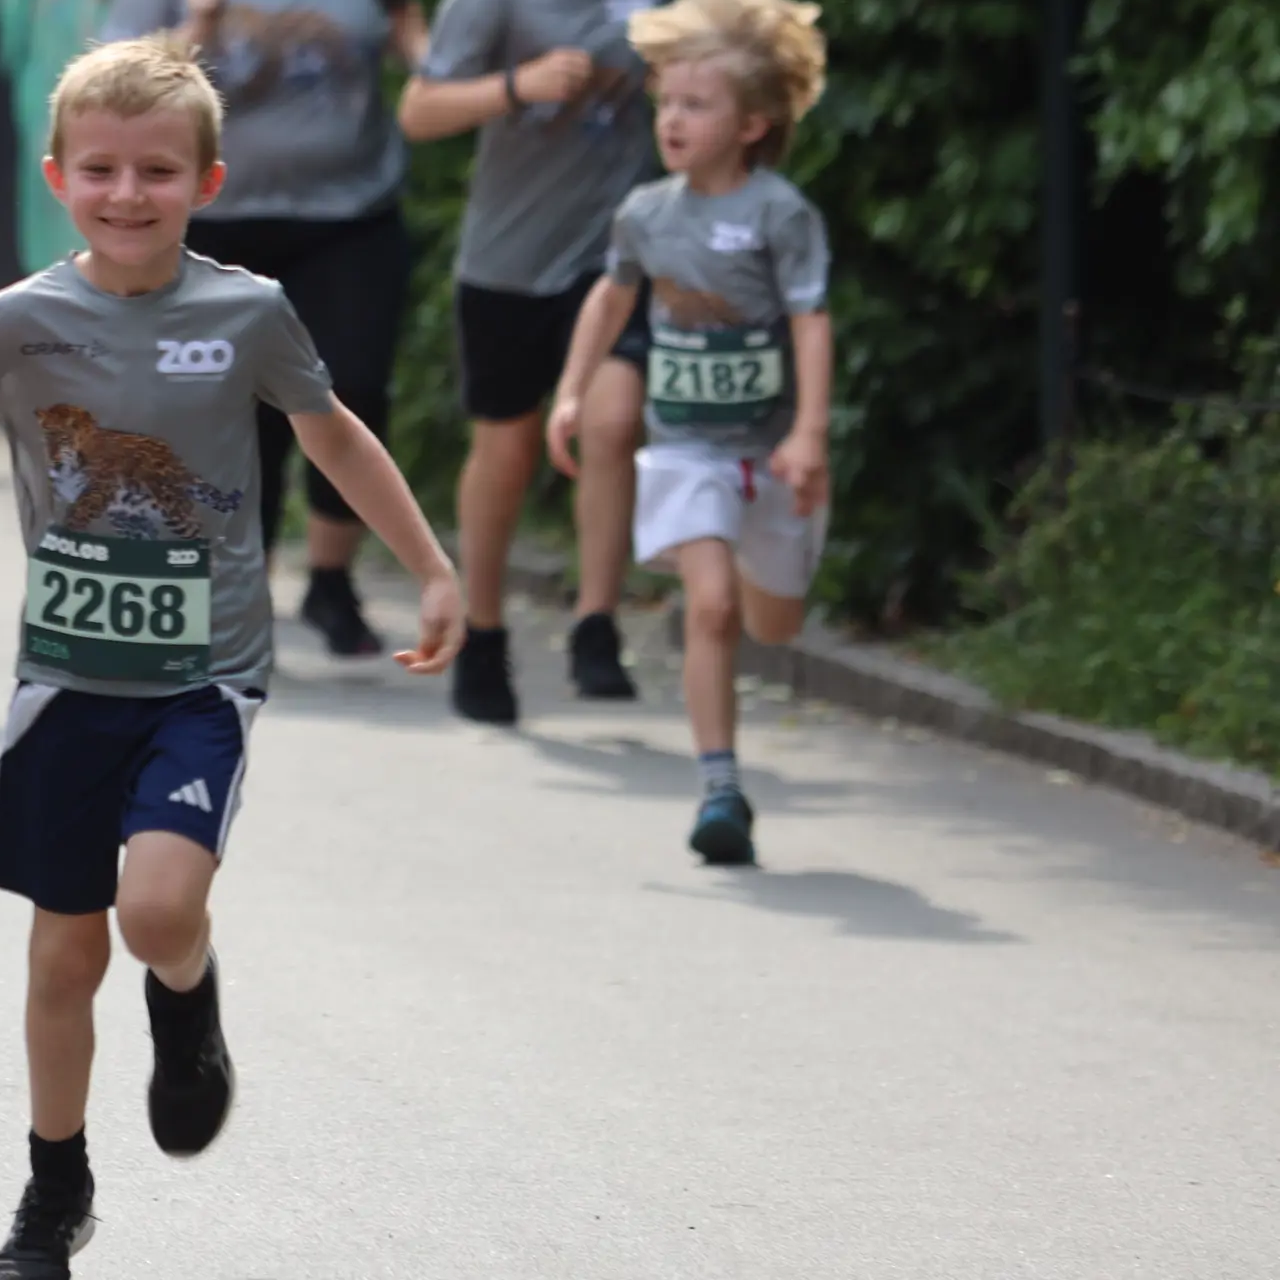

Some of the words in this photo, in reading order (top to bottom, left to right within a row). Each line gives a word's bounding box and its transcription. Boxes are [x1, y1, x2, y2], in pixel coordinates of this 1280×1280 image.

[157, 340, 234, 373] ZOO
[661, 358, 762, 400] 2182
[42, 569, 186, 640] 2268
